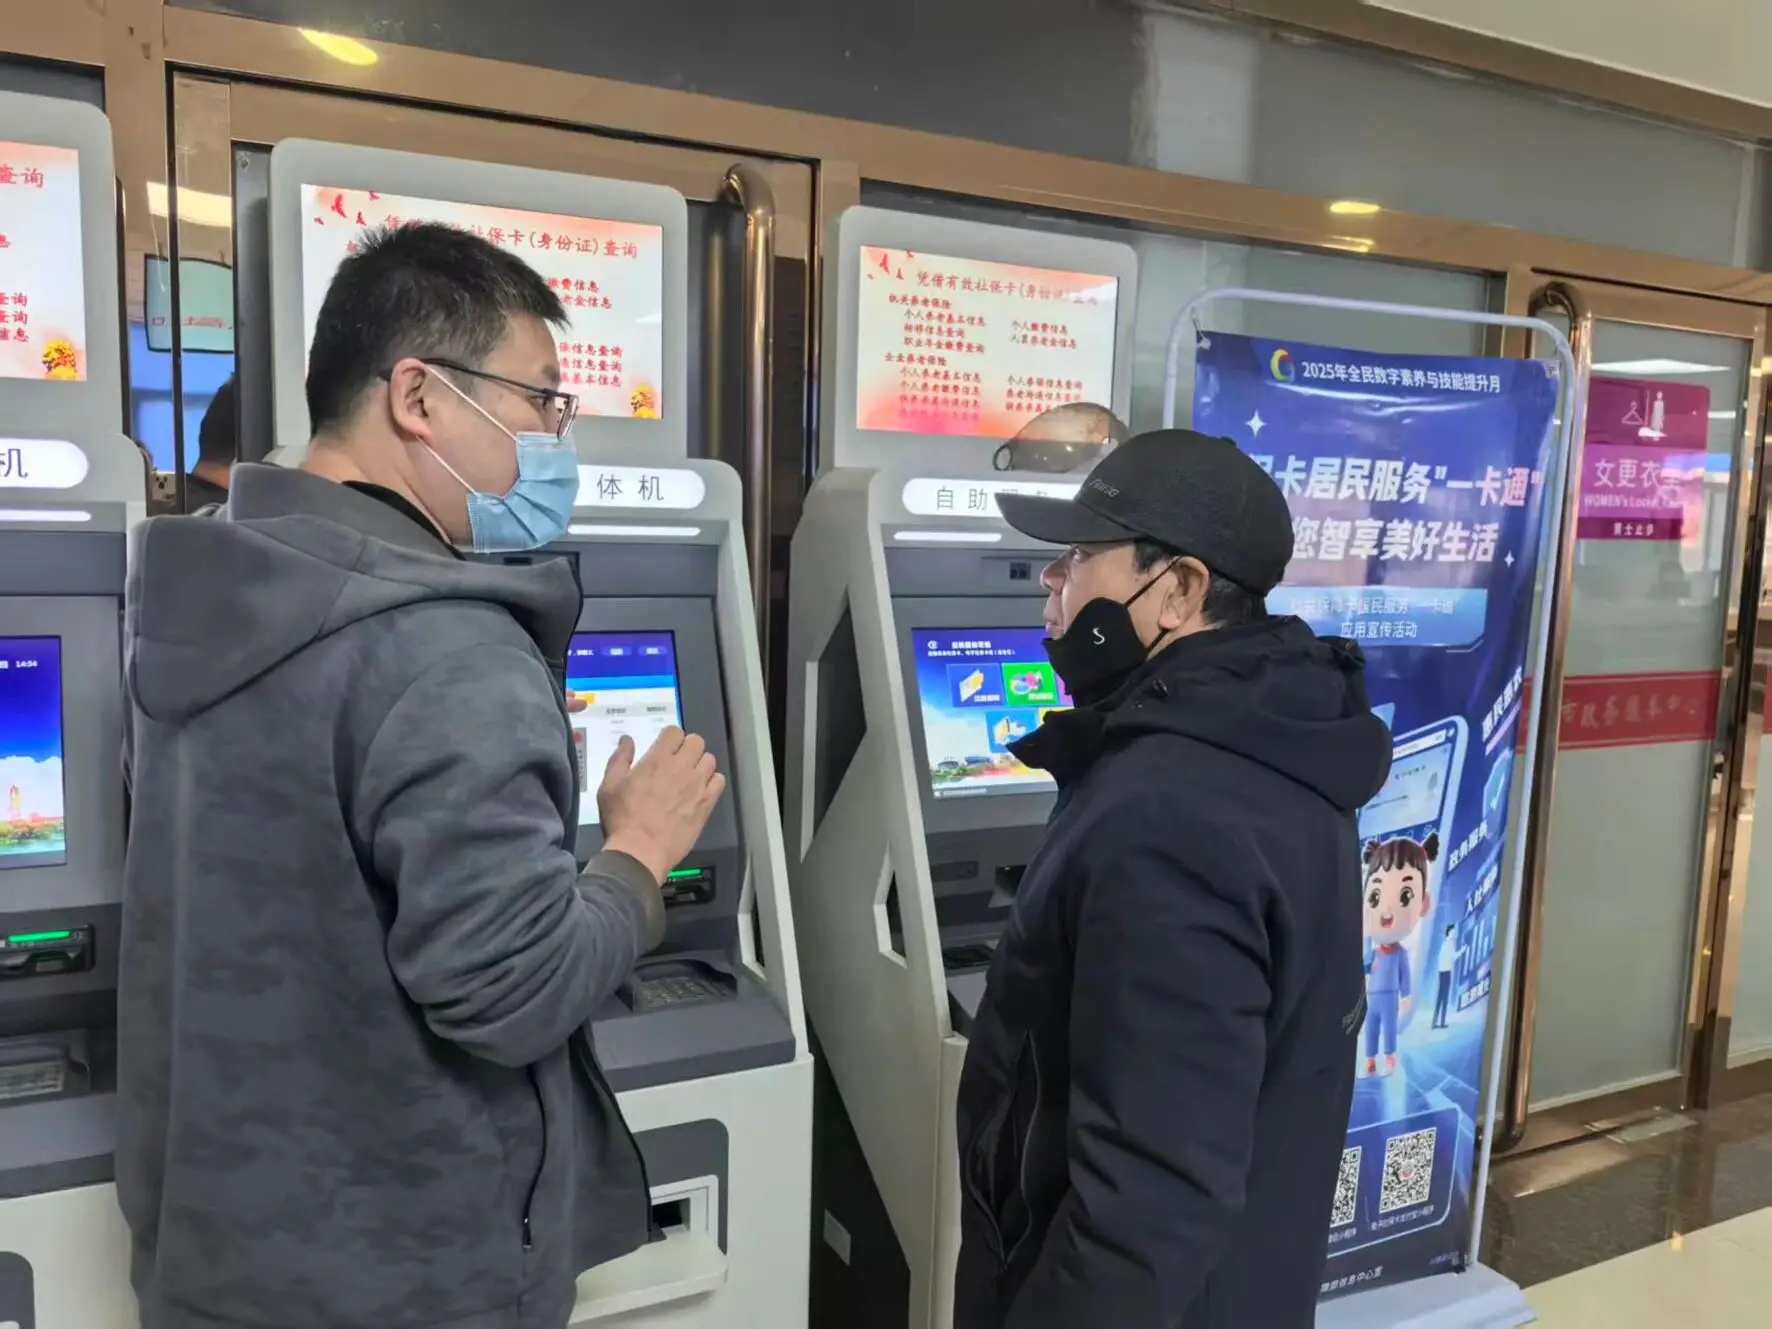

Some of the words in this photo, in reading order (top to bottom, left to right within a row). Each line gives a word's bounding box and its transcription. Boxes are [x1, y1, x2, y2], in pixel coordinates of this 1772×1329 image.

[1302, 361, 1501, 393] 2025年全民数字素养与技能提升月
[597, 473, 665, 501] 体机
[1293, 517, 1499, 562] 您智享美好生活
[1092, 626, 1105, 645] S
[1340, 622, 1418, 638] 应用宣传活动
